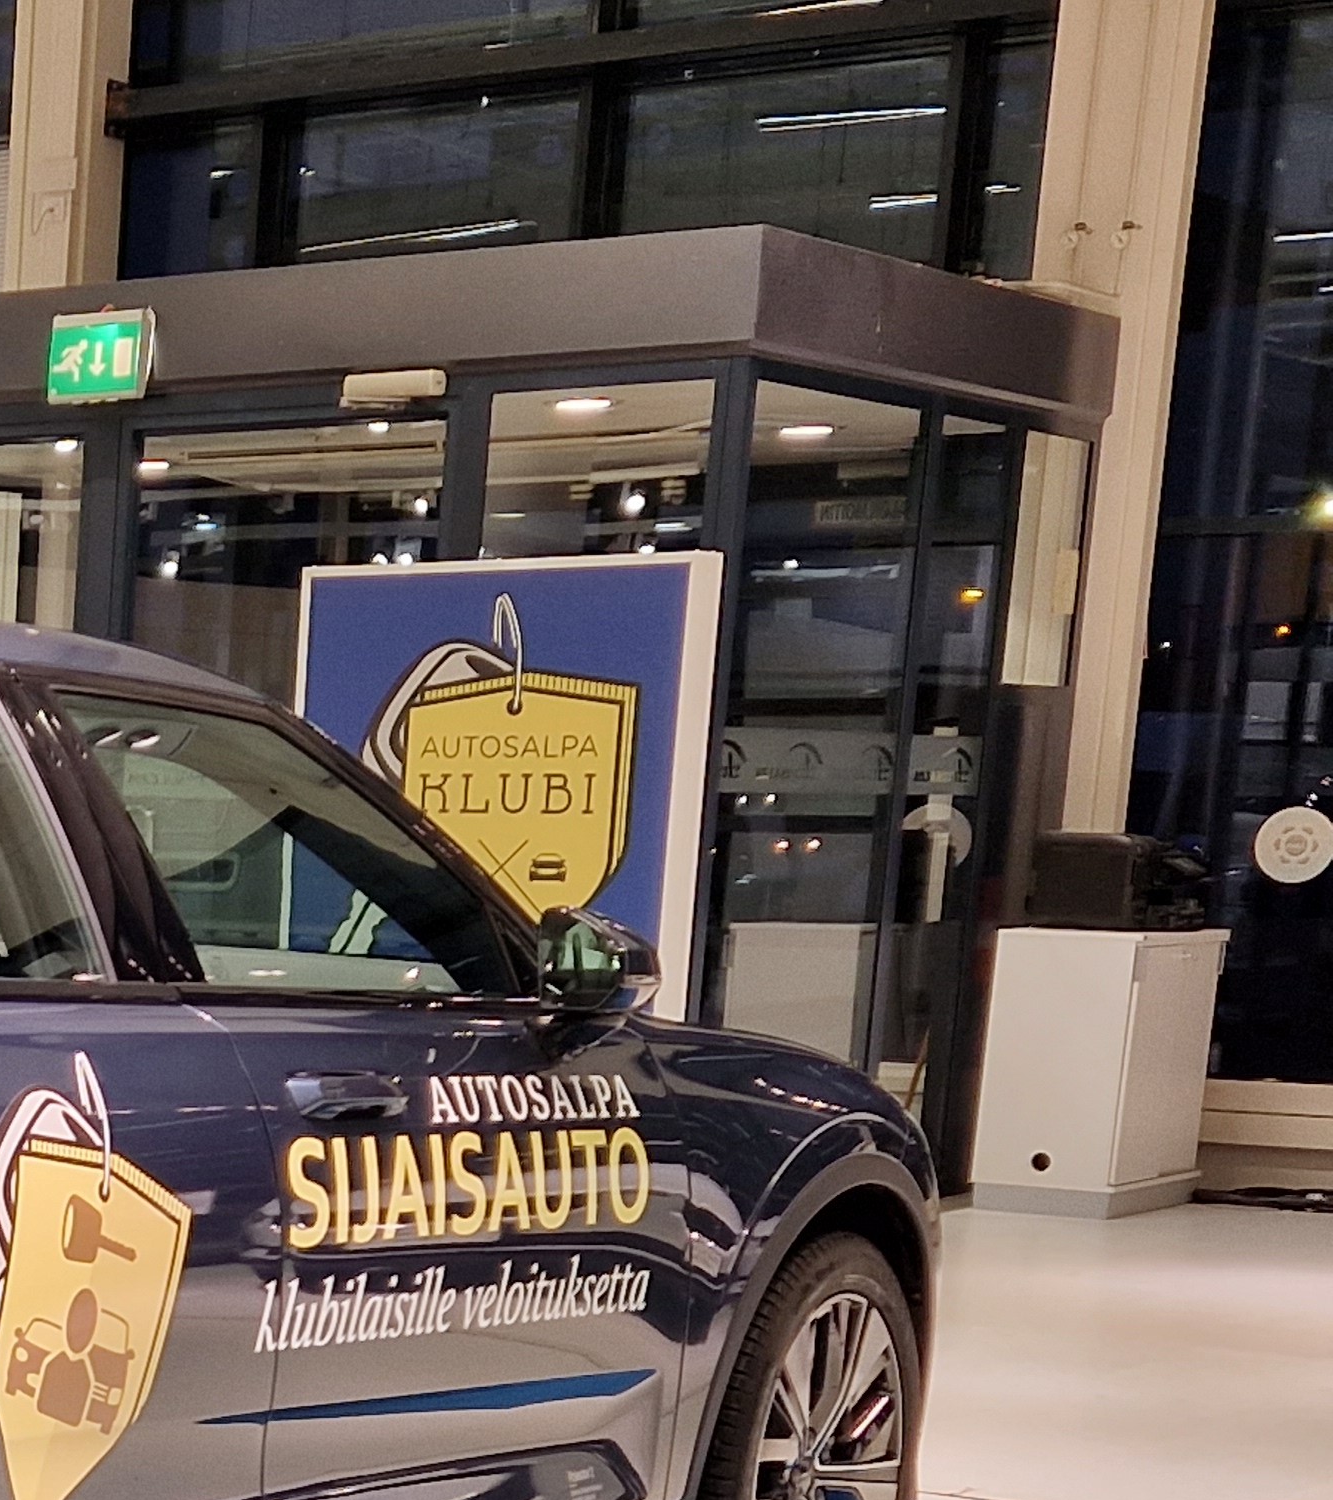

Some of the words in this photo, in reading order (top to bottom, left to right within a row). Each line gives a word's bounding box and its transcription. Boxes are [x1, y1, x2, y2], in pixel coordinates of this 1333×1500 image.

[420, 734, 599, 759] AUTOSALPA
[418, 772, 597, 815] KLUBI
[429, 1073, 641, 1125] AUTOSALPA
[286, 1126, 651, 1250] SIJAISAUTO
[253, 1264, 454, 1354] klubilaisille
[462, 1253, 651, 1331] veloituksetta
